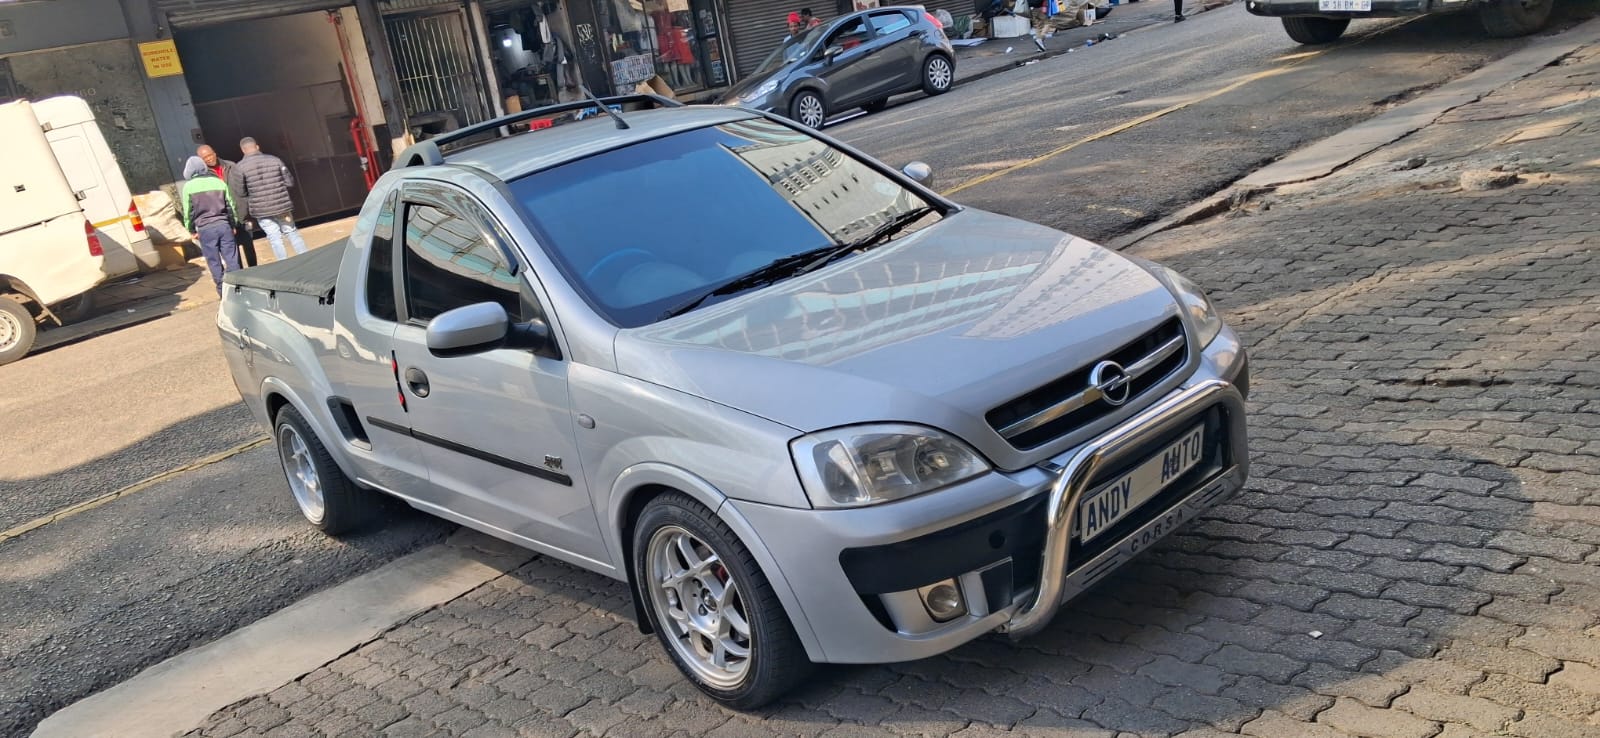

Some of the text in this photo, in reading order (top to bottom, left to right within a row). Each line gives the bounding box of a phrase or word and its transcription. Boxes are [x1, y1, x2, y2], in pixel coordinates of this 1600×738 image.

[1086, 477, 1132, 536] ANDY
[1160, 431, 1201, 484] AUTO
[1130, 510, 1183, 552] CORSA
